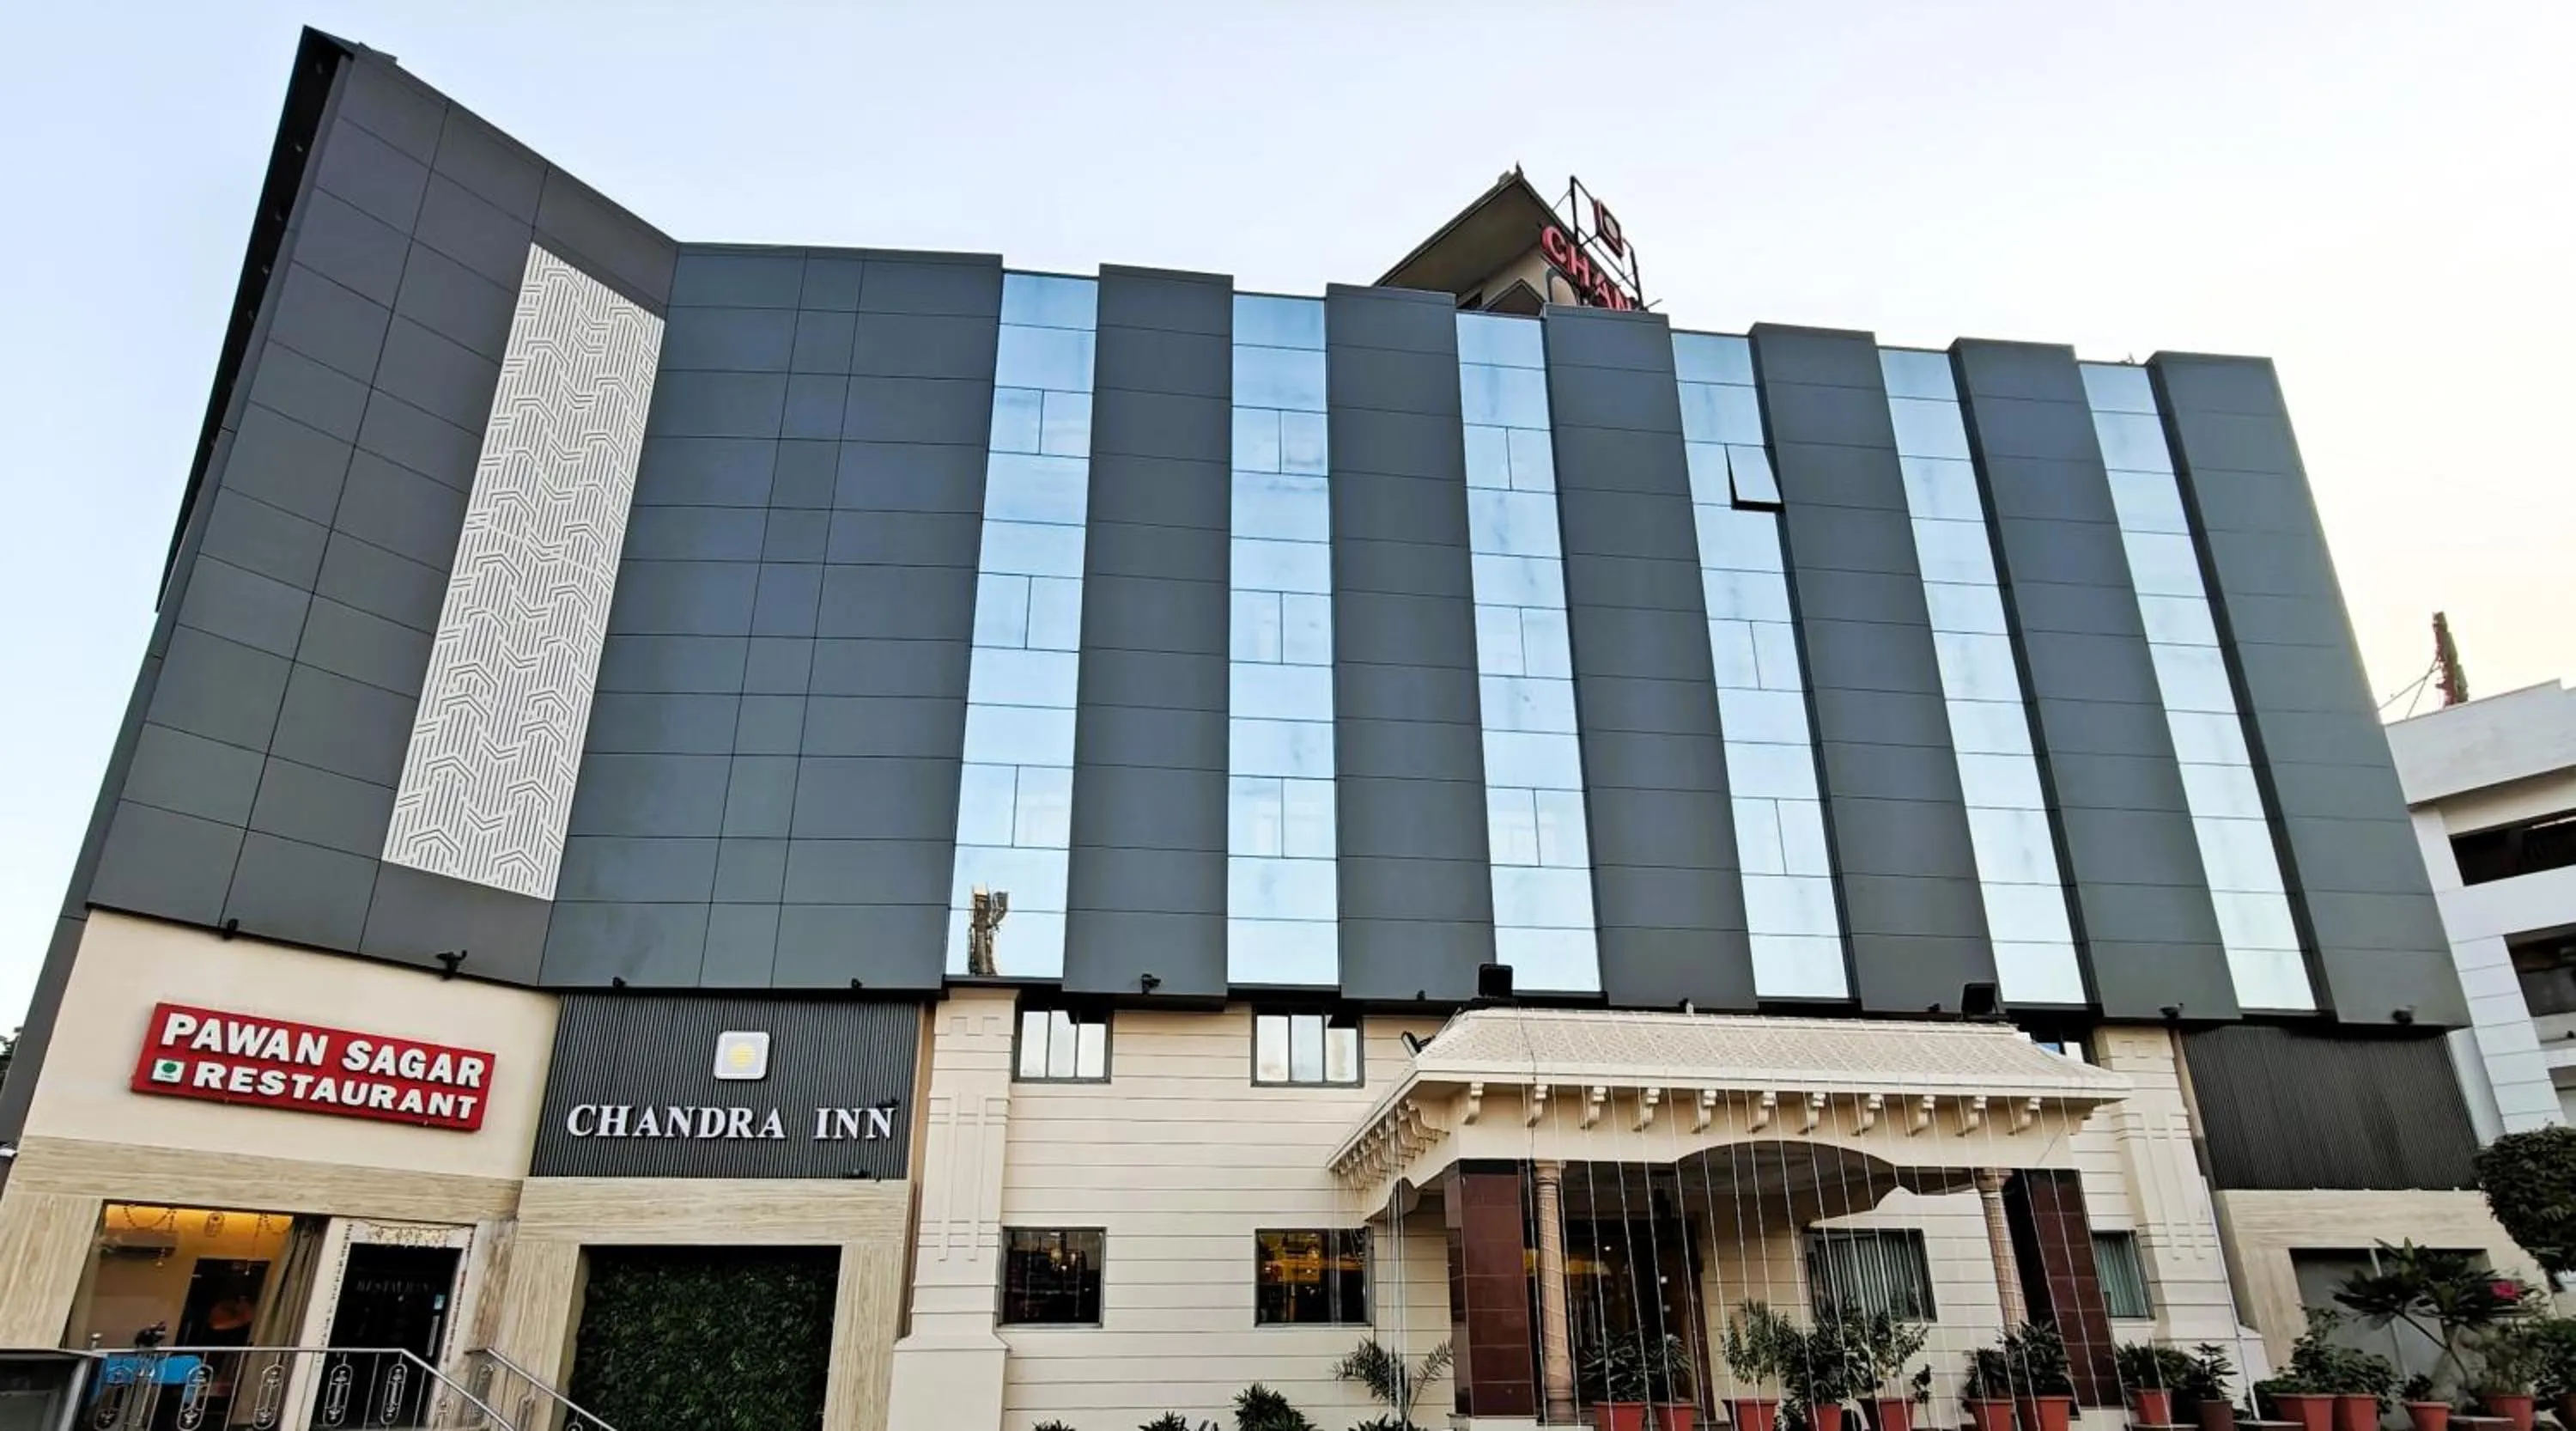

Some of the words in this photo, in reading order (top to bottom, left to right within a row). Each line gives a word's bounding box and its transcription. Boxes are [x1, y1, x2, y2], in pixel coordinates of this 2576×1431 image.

[161, 1013, 329, 1066] PAWAN
[342, 1040, 485, 1087] SAGAR
[192, 1061, 478, 1119] RESTAURANT
[567, 1103, 787, 1139] CHANDRA
[813, 1107, 896, 1140] INN
